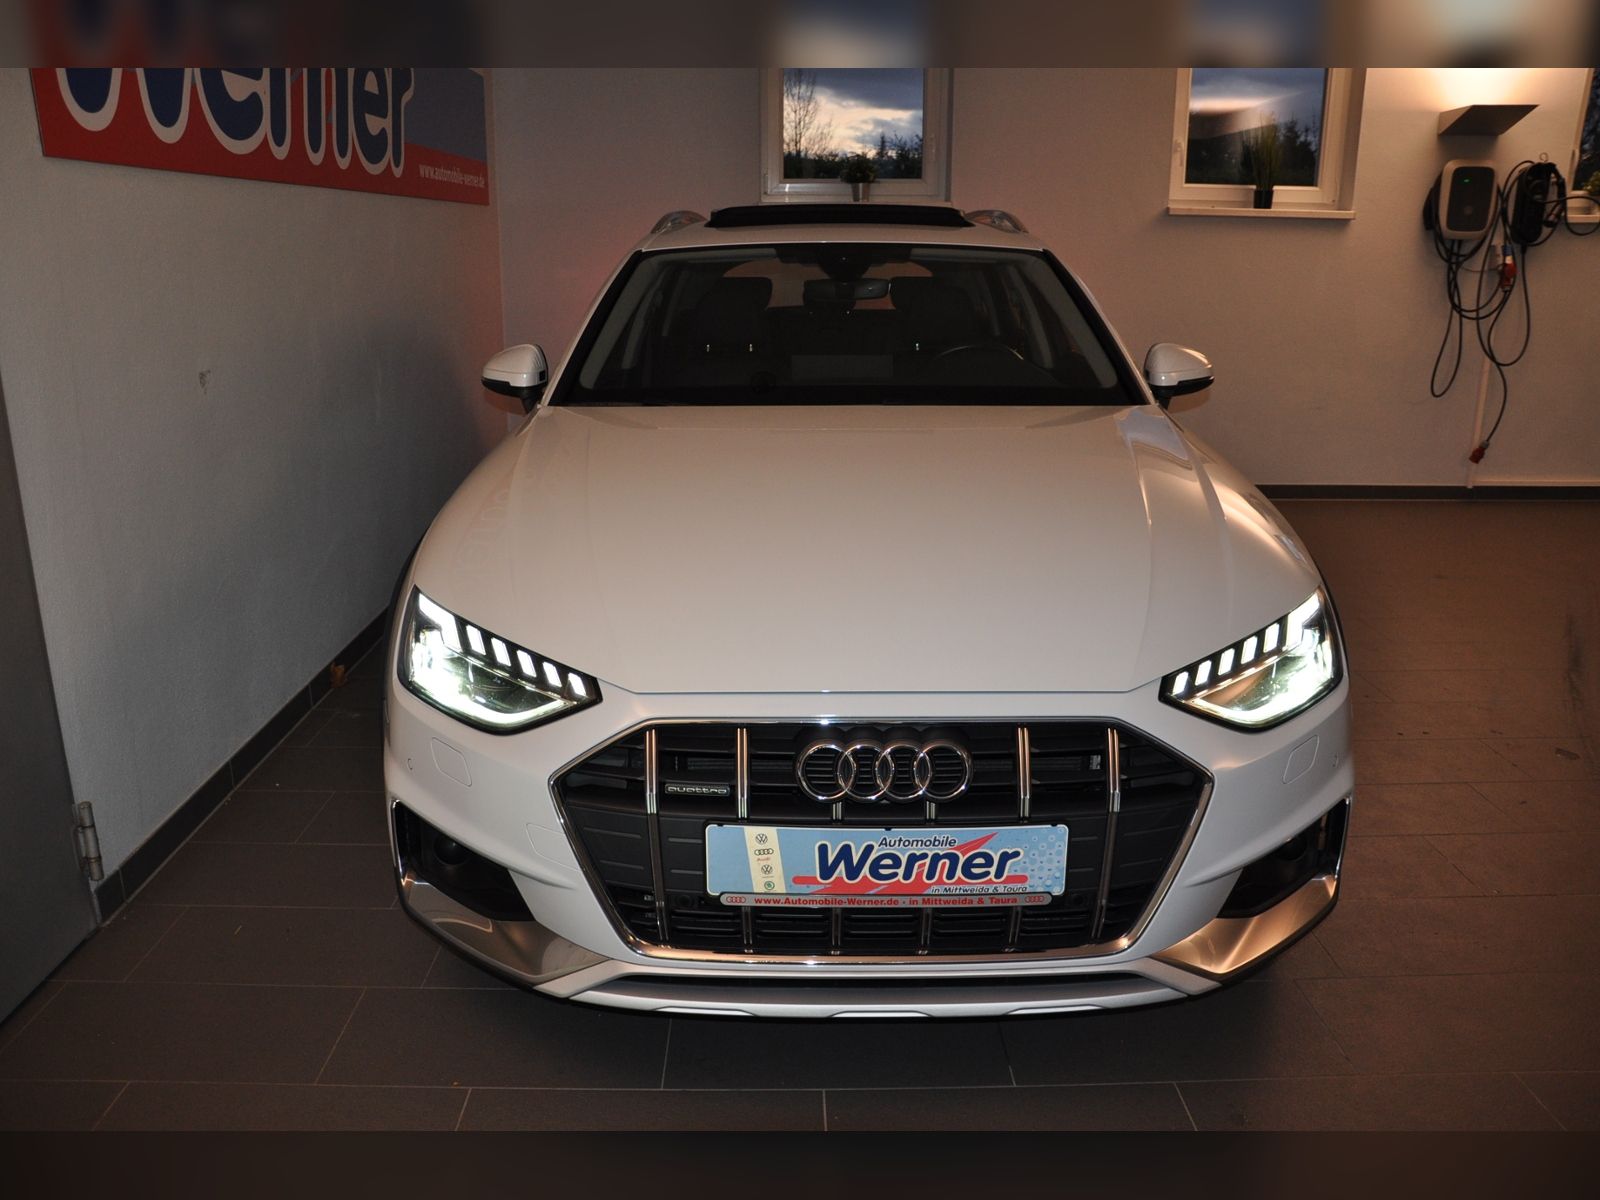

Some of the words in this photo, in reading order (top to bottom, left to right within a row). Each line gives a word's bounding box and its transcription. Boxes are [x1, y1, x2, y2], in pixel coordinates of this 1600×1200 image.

[56, 68, 413, 177] erner
[667, 786, 727, 794] quattro
[877, 836, 957, 848] Automobile
[816, 842, 1022, 882] Werner
[754, 897, 899, 906] www.Automobile-Werner.de
[909, 897, 918, 905] in
[922, 897, 973, 905] Mittweida
[977, 897, 984, 905] &
[989, 896, 1018, 904] Taura
